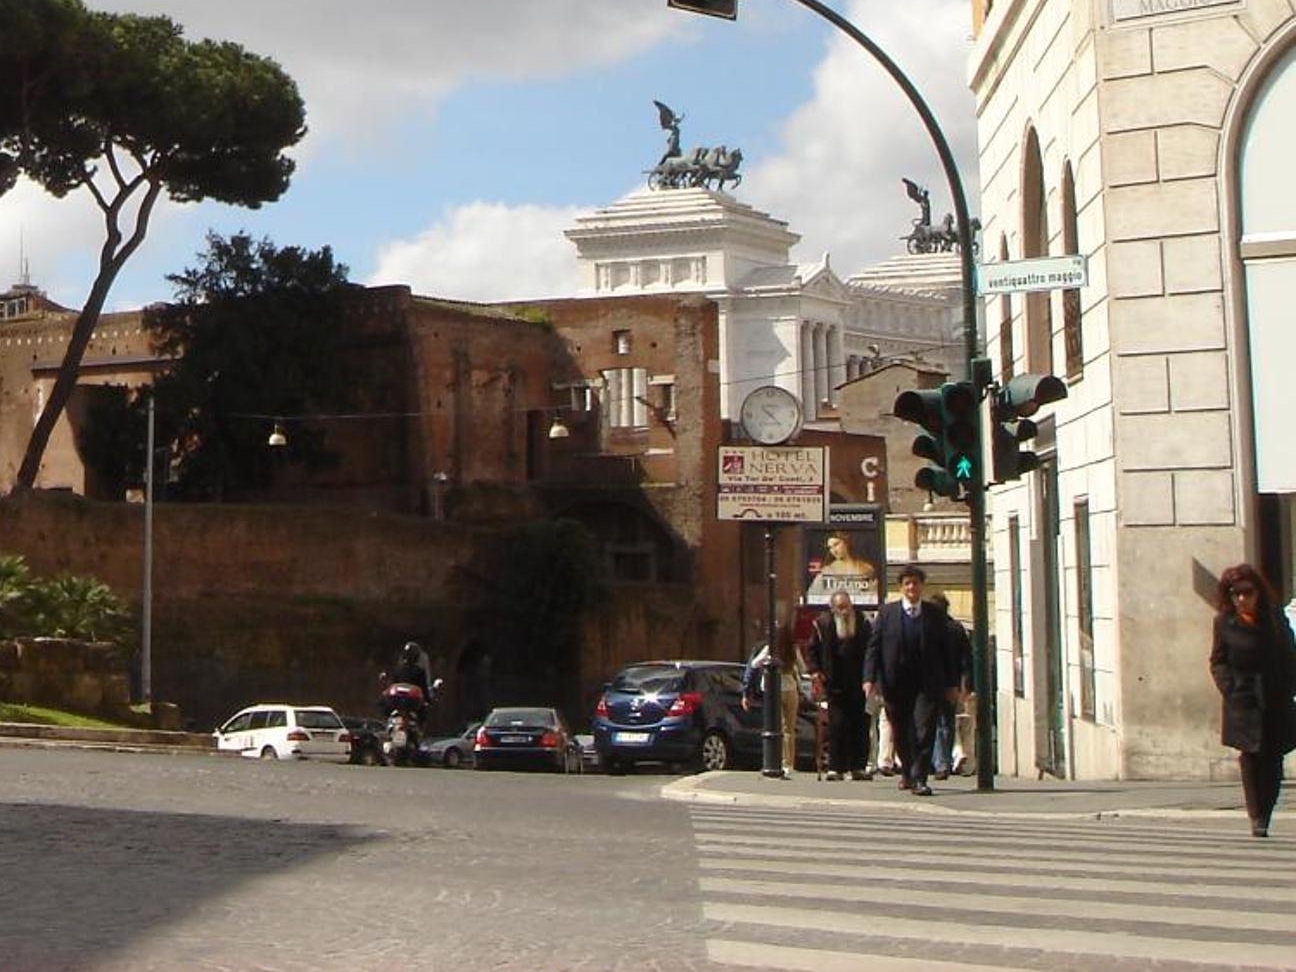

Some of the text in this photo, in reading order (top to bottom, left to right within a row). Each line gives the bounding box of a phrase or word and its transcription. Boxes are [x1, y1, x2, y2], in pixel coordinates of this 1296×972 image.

[988, 271, 1082, 289] ventiquattro maggio
[751, 451, 816, 461] HOTEL
[749, 463, 817, 474] NERVA
[823, 577, 869, 590] Tiziano
